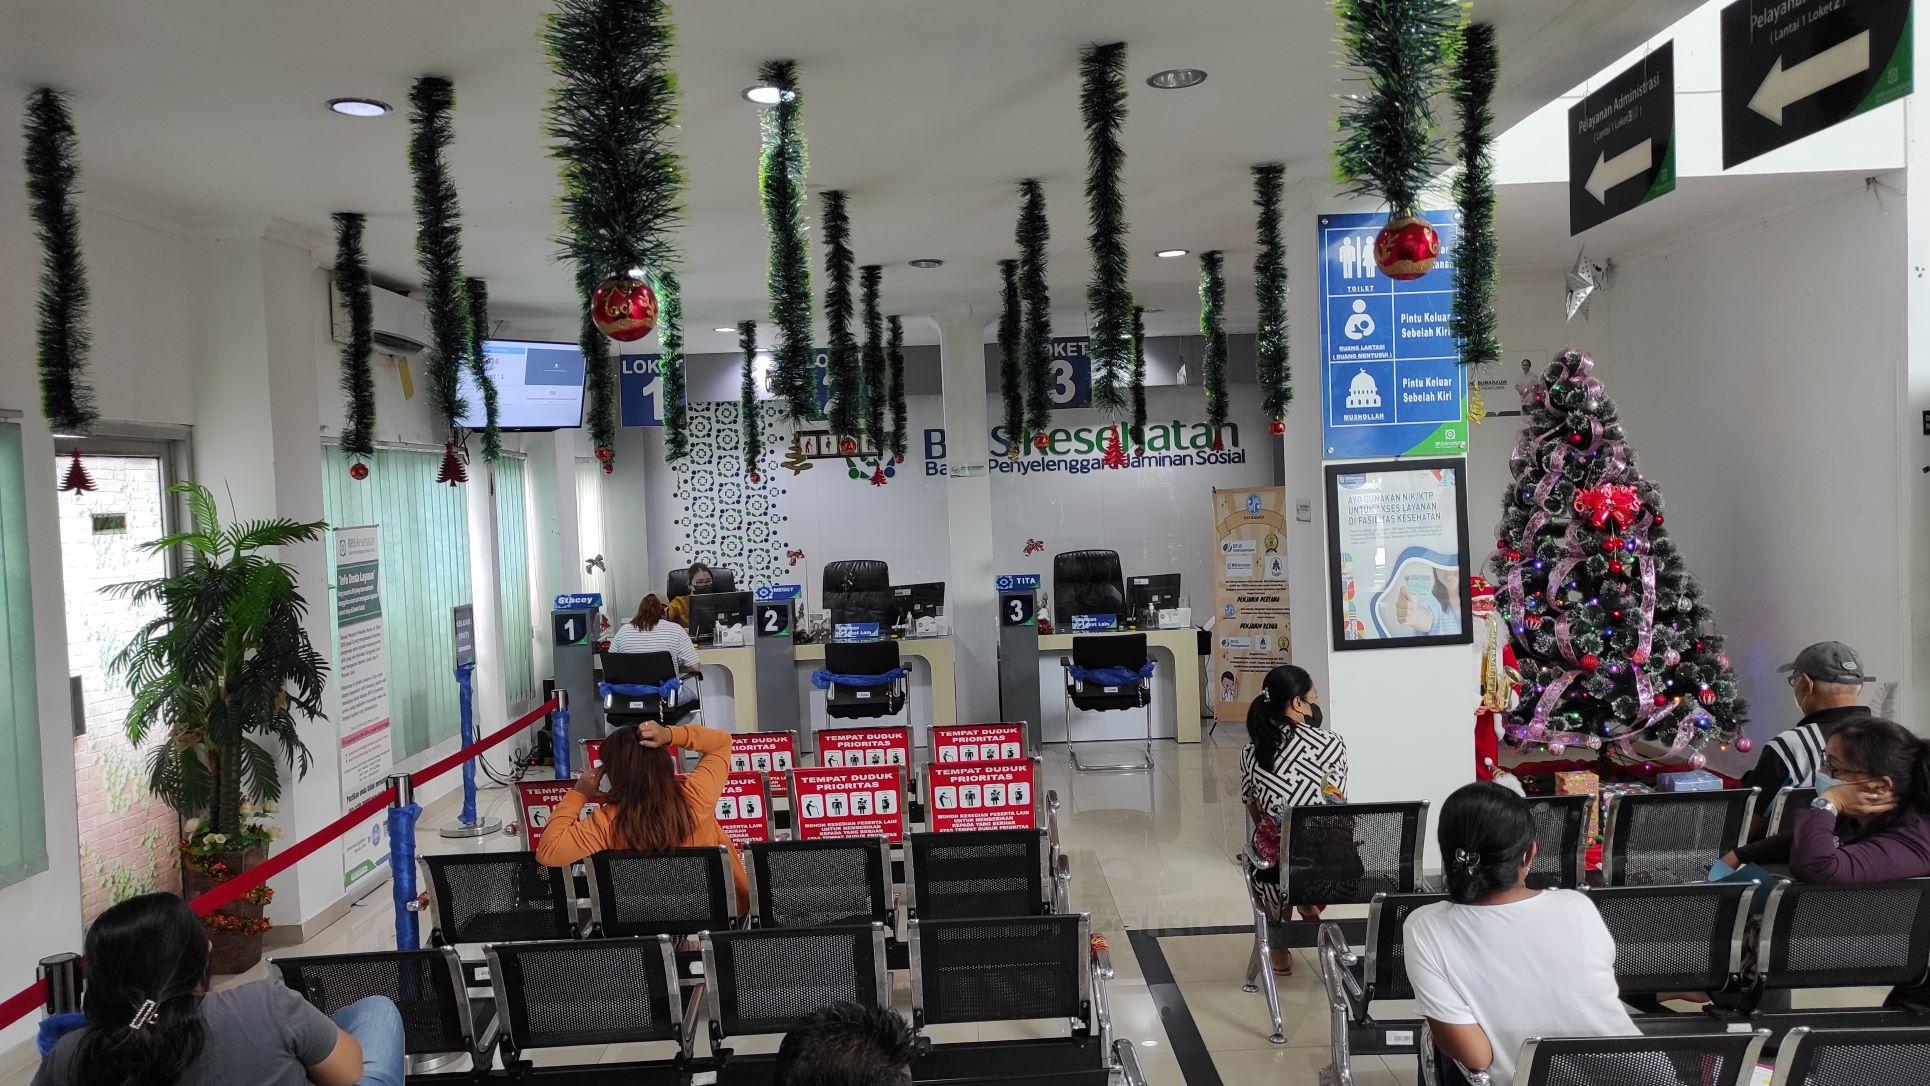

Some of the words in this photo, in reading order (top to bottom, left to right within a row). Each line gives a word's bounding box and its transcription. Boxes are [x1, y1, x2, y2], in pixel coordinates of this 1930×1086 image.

[1808, 2, 1833, 23] Loket
[1578, 104, 1612, 133] Pelayanan
[1613, 71, 1660, 112] Administrasi
[1346, 285, 1375, 293] TOILET
[1401, 312, 1422, 324] Pintu
[1402, 327, 1434, 339] Sebelah
[1048, 358, 1076, 404] 3
[1402, 377, 1424, 389] Pintu
[1425, 376, 1453, 388] Keluar
[1403, 391, 1435, 403] Sebelah
[1437, 390, 1452, 401] Kiri
[1343, 413, 1385, 421] MUSHOLLAH
[1195, 448, 1246, 466] Sosial
[1347, 495, 1362, 505] AYO
[1363, 493, 1401, 504] GUNAKAN
[1402, 491, 1434, 502] NIK/KTP
[1348, 505, 1375, 515] UNTUK
[1376, 504, 1400, 514] AKSES
[1402, 502, 1437, 512] LAYANAN
[1348, 516, 1357, 525] DI
[1397, 512, 1441, 523] KESEHATAN
[1016, 577, 1036, 585] TITA
[558, 595, 593, 605] Stacey
[1010, 599, 1024, 622] 3
[764, 610, 779, 632] 2
[564, 618, 575, 641] 1
[938, 729, 979, 737] TEMPAT
[952, 735, 1006, 743] PRIORITAS
[935, 767, 982, 776] TEMPAT
[984, 765, 1028, 773] DUDUK
[800, 775, 848, 784] TEMPAT
[850, 772, 894, 781] DUDUK
[950, 773, 1014, 783] PRIORITAS
[816, 781, 880, 791] PRIORITAS
